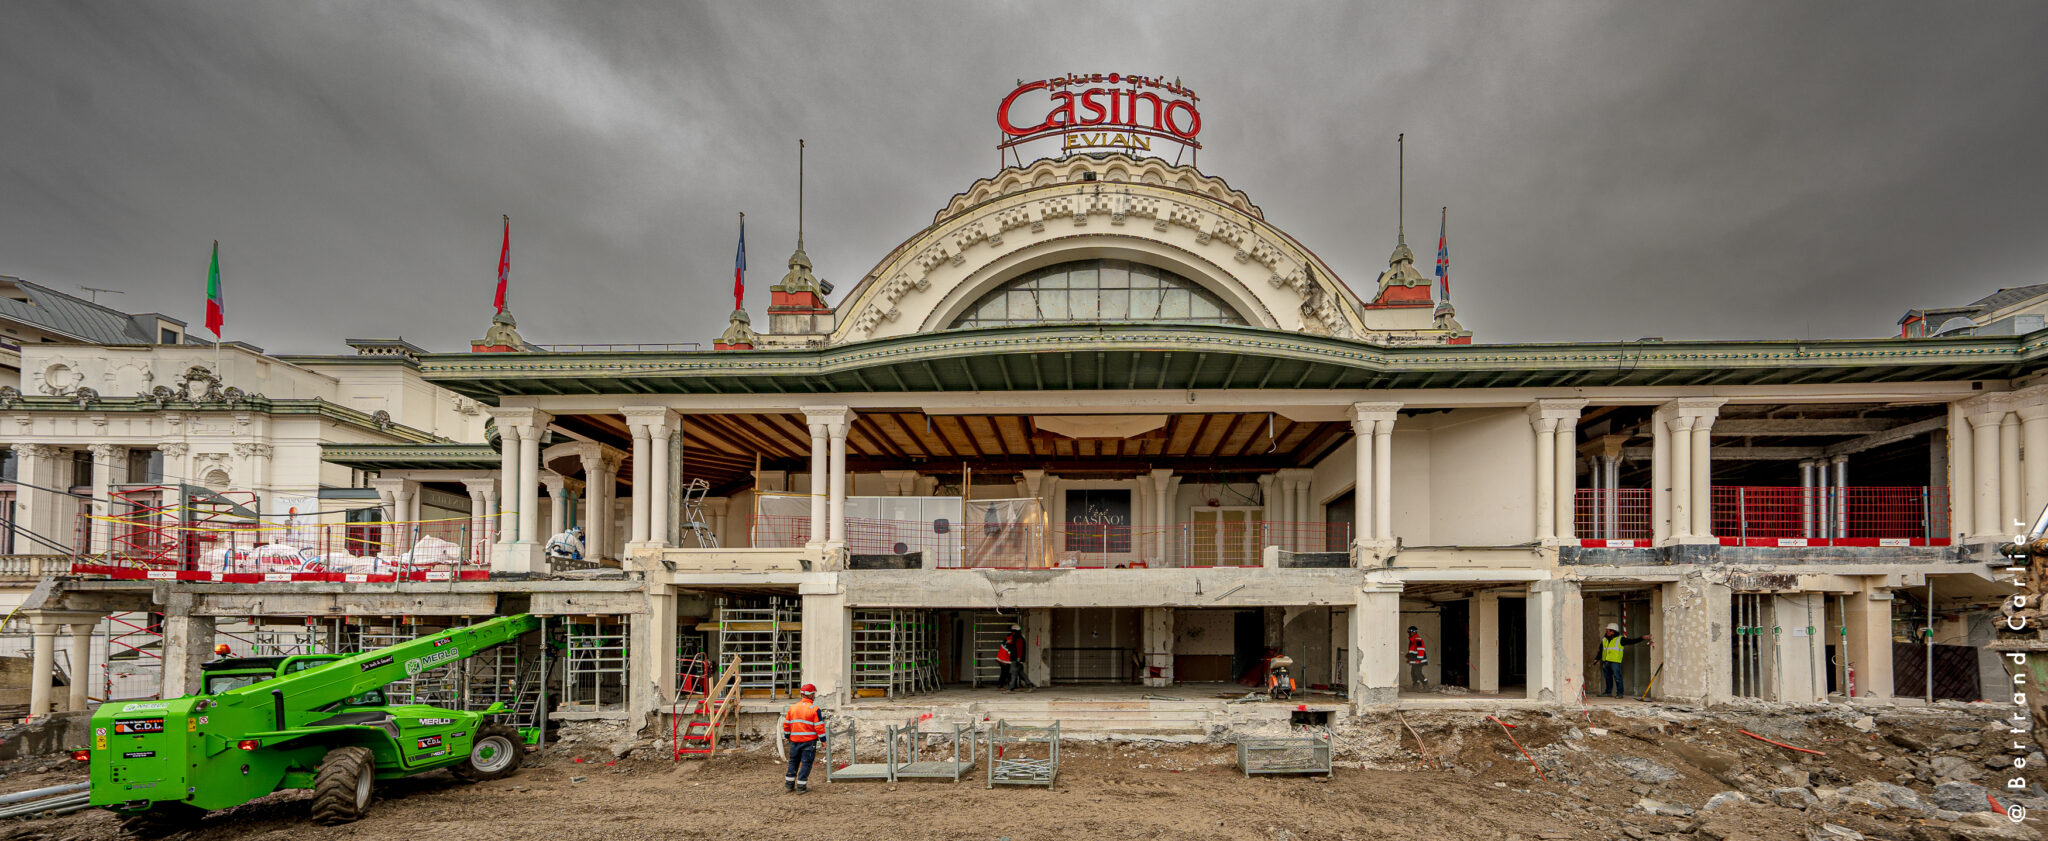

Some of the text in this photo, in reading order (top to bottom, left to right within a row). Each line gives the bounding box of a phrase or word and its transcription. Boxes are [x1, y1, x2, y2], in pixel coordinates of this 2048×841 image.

[1049, 72, 1102, 91] plus
[997, 80, 1202, 139] Casino
[1066, 133, 1151, 150] EVIAN
[422, 647, 459, 664] MERLO
